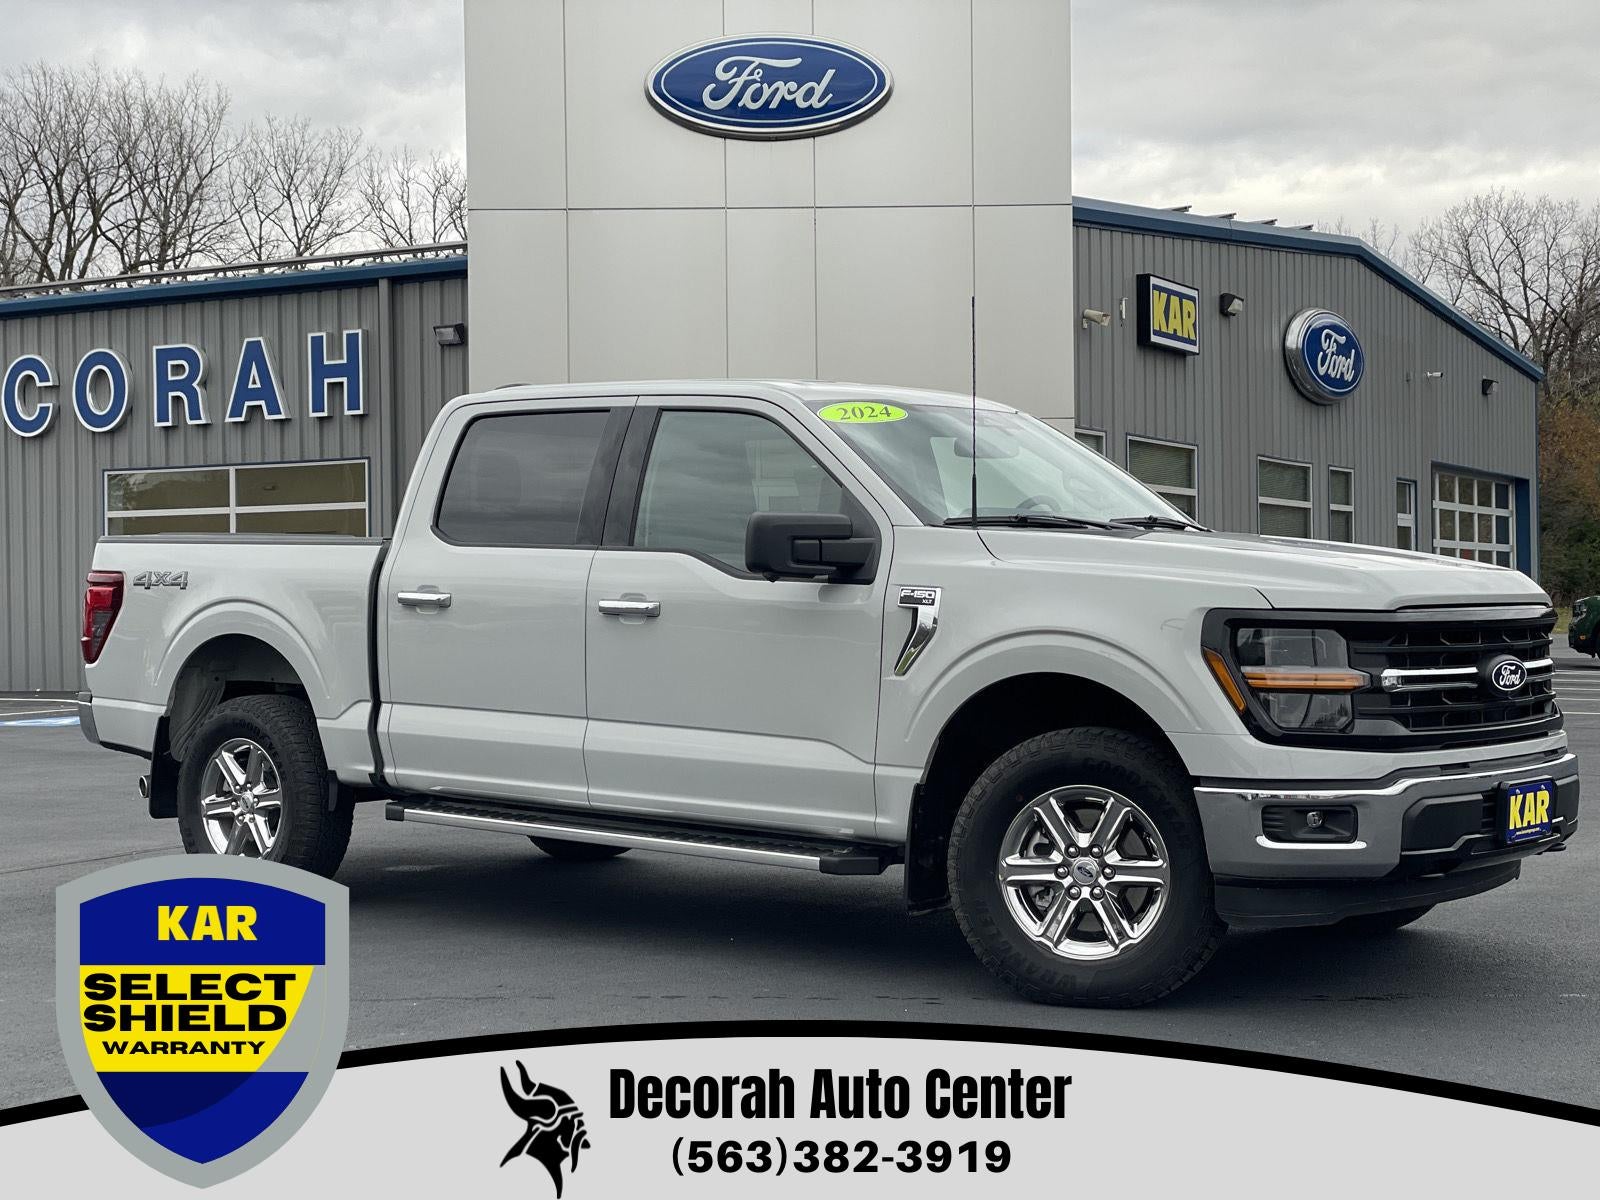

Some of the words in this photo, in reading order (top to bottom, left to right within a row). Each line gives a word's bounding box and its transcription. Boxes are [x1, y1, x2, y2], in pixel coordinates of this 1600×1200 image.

[702, 55, 836, 110] Ford
[1152, 289, 1197, 341] KAR
[1317, 328, 1356, 382] Ford
[1, 328, 368, 438] CORAH
[836, 405, 892, 420] 2024
[900, 589, 936, 599] F-150
[1499, 664, 1521, 686] Ford
[1509, 790, 1550, 830] KAR
